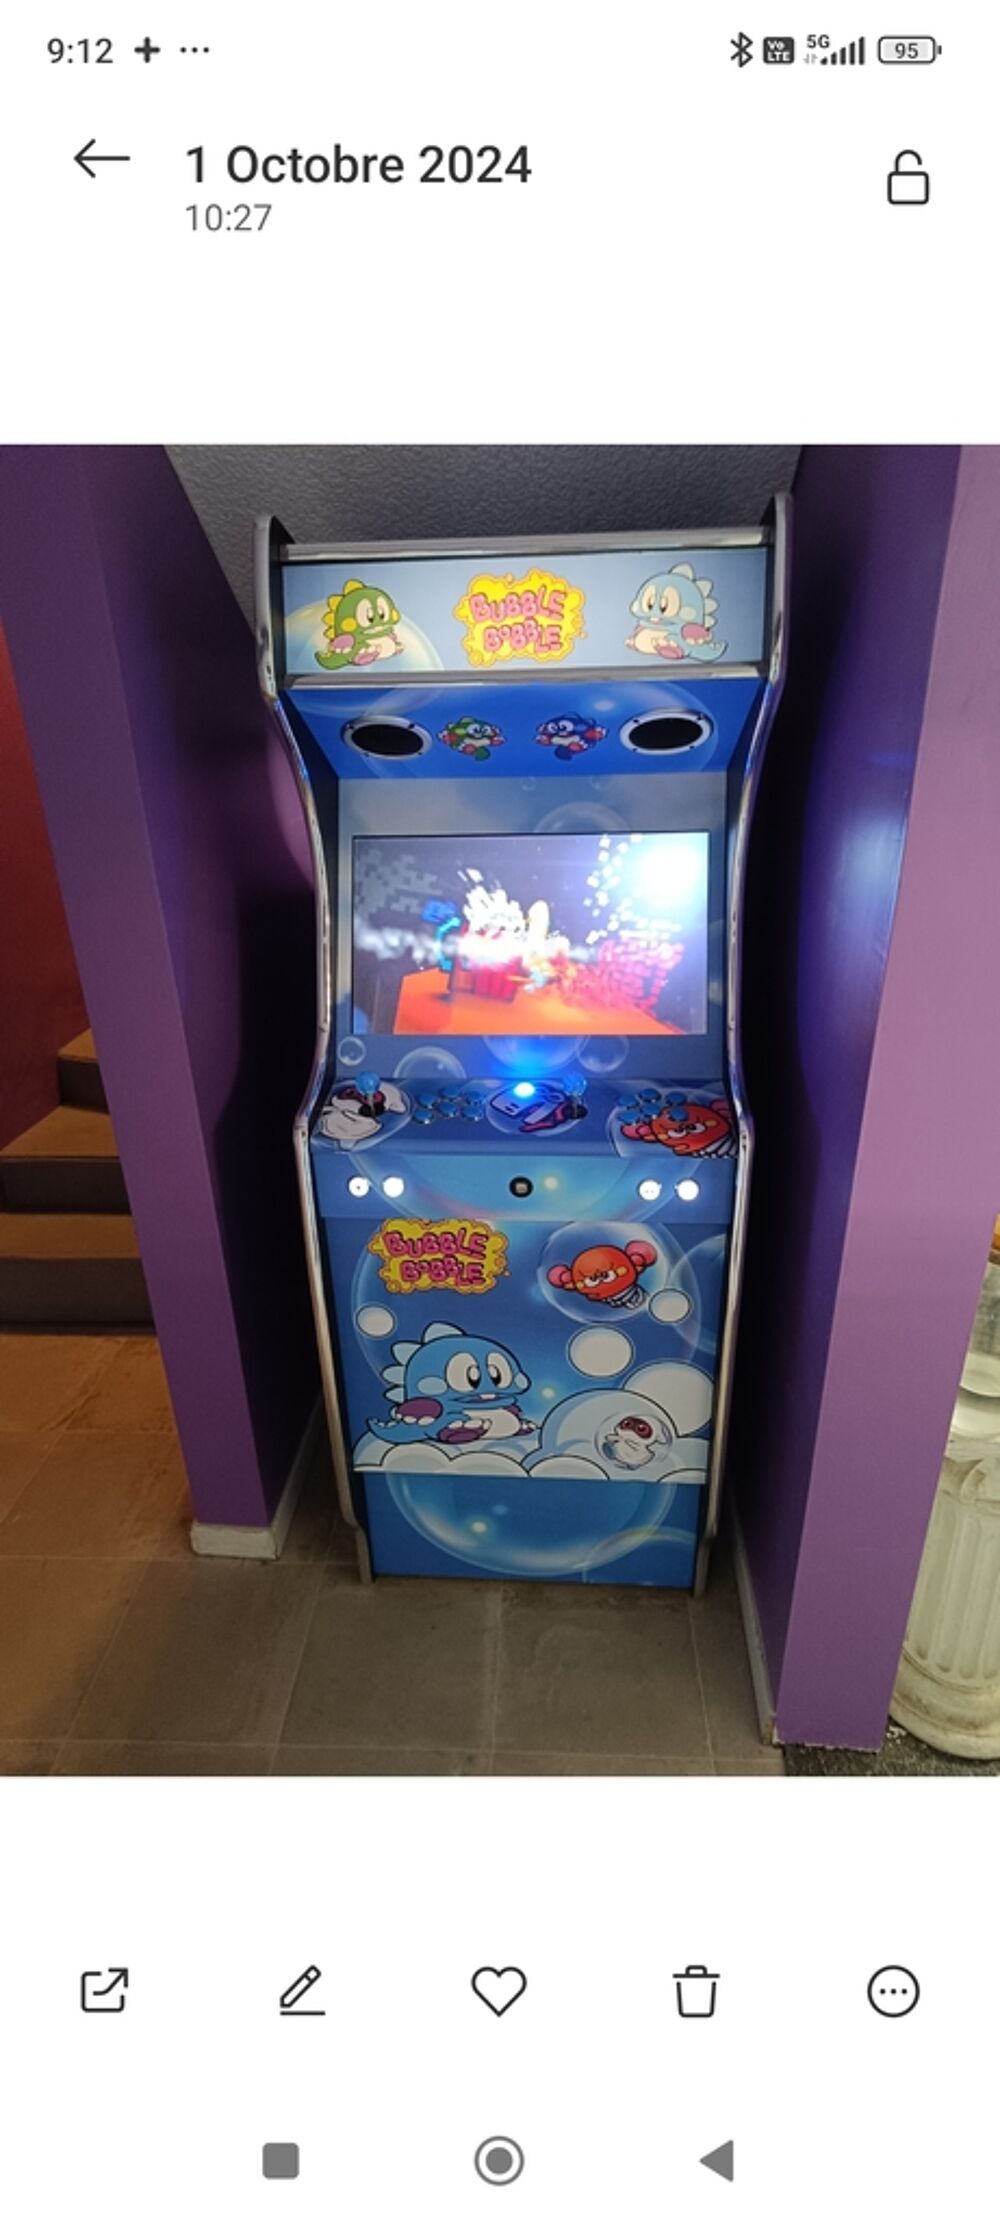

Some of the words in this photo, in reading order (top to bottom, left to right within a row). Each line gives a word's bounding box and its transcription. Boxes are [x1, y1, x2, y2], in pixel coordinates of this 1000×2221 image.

[470, 584, 567, 621] BUBBLE
[485, 617, 563, 652] BOBBLE
[385, 1228, 488, 1257] BUBBLE
[401, 1255, 485, 1285] BOBBLE
